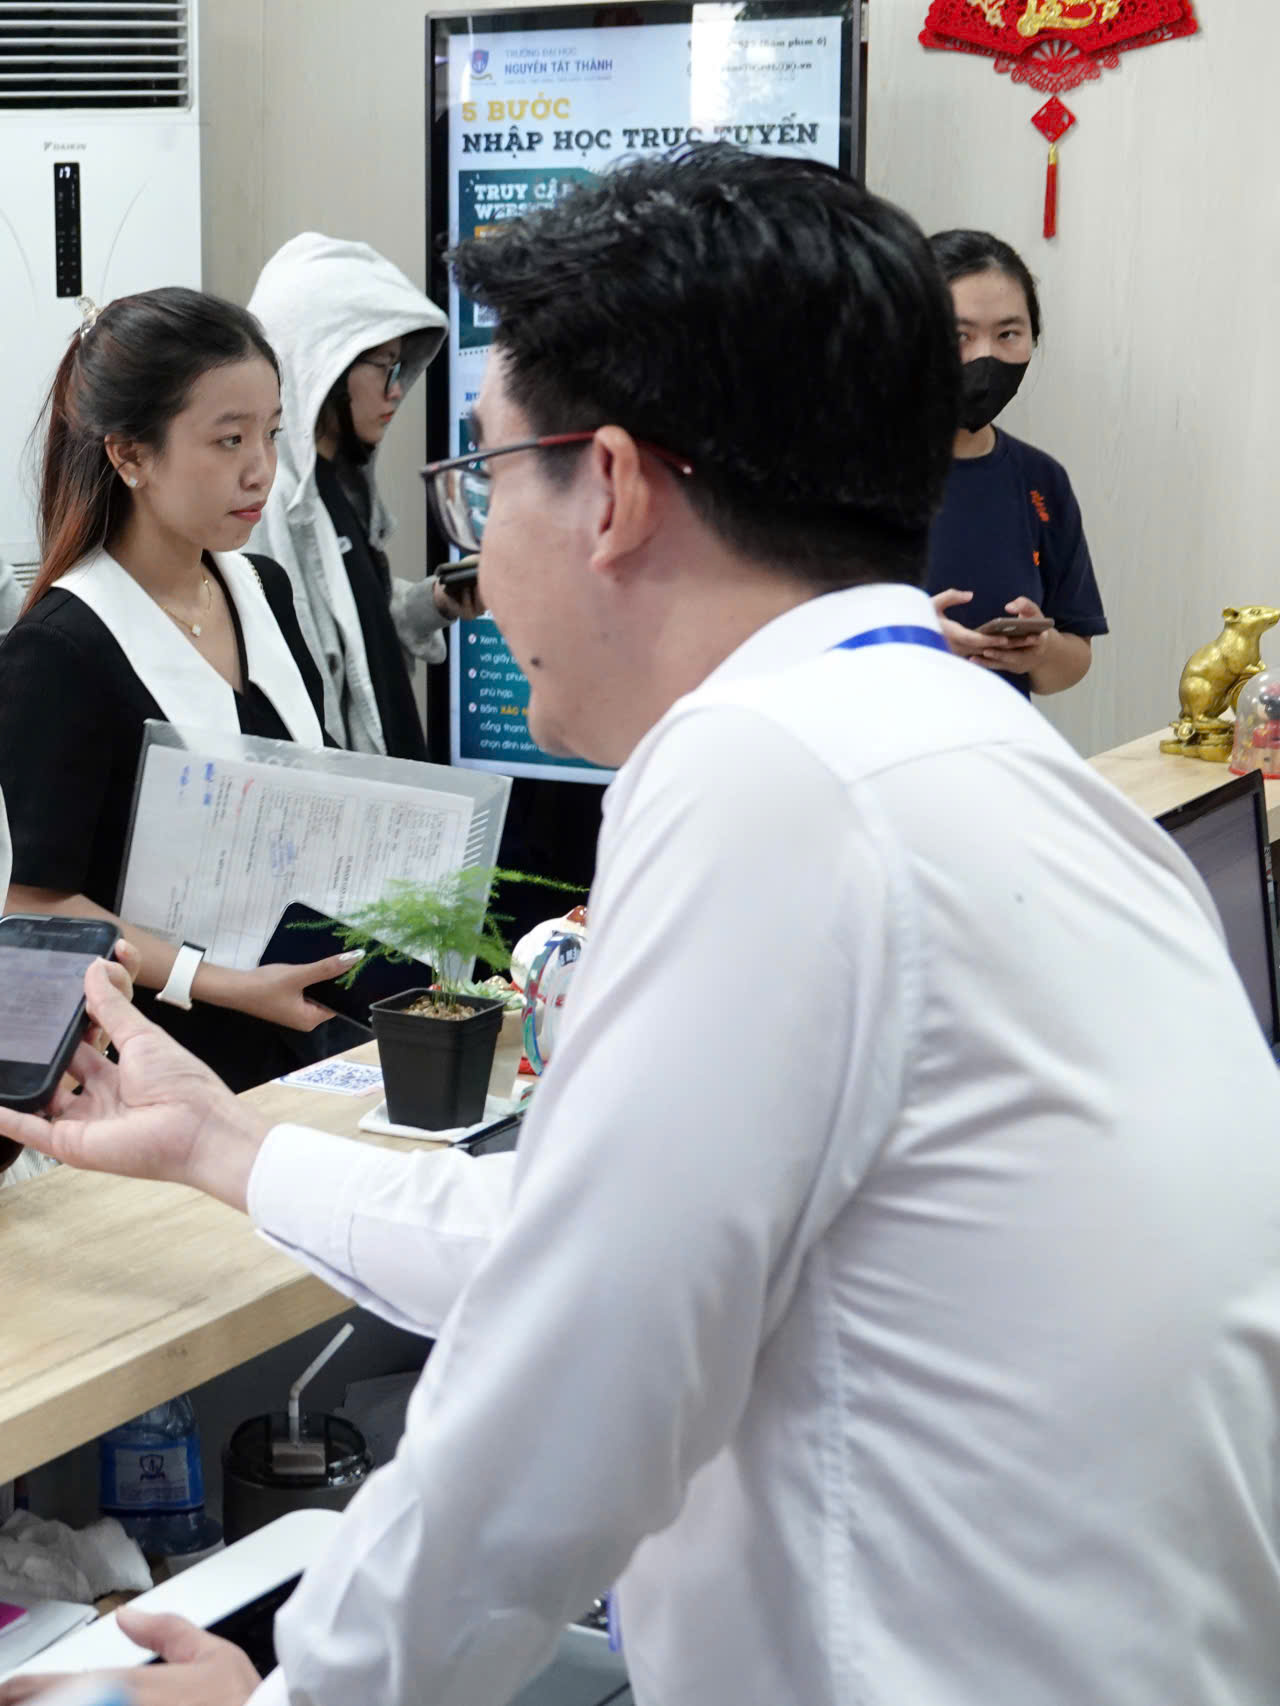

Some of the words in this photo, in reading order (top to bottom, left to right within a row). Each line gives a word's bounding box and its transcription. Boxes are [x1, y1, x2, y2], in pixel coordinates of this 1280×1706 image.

[462, 101, 477, 122] 5
[488, 91, 571, 122] BƯỚC
[462, 125, 543, 158] NHẬP
[553, 129, 612, 157] HỌC
[474, 183, 528, 201] TRUY
